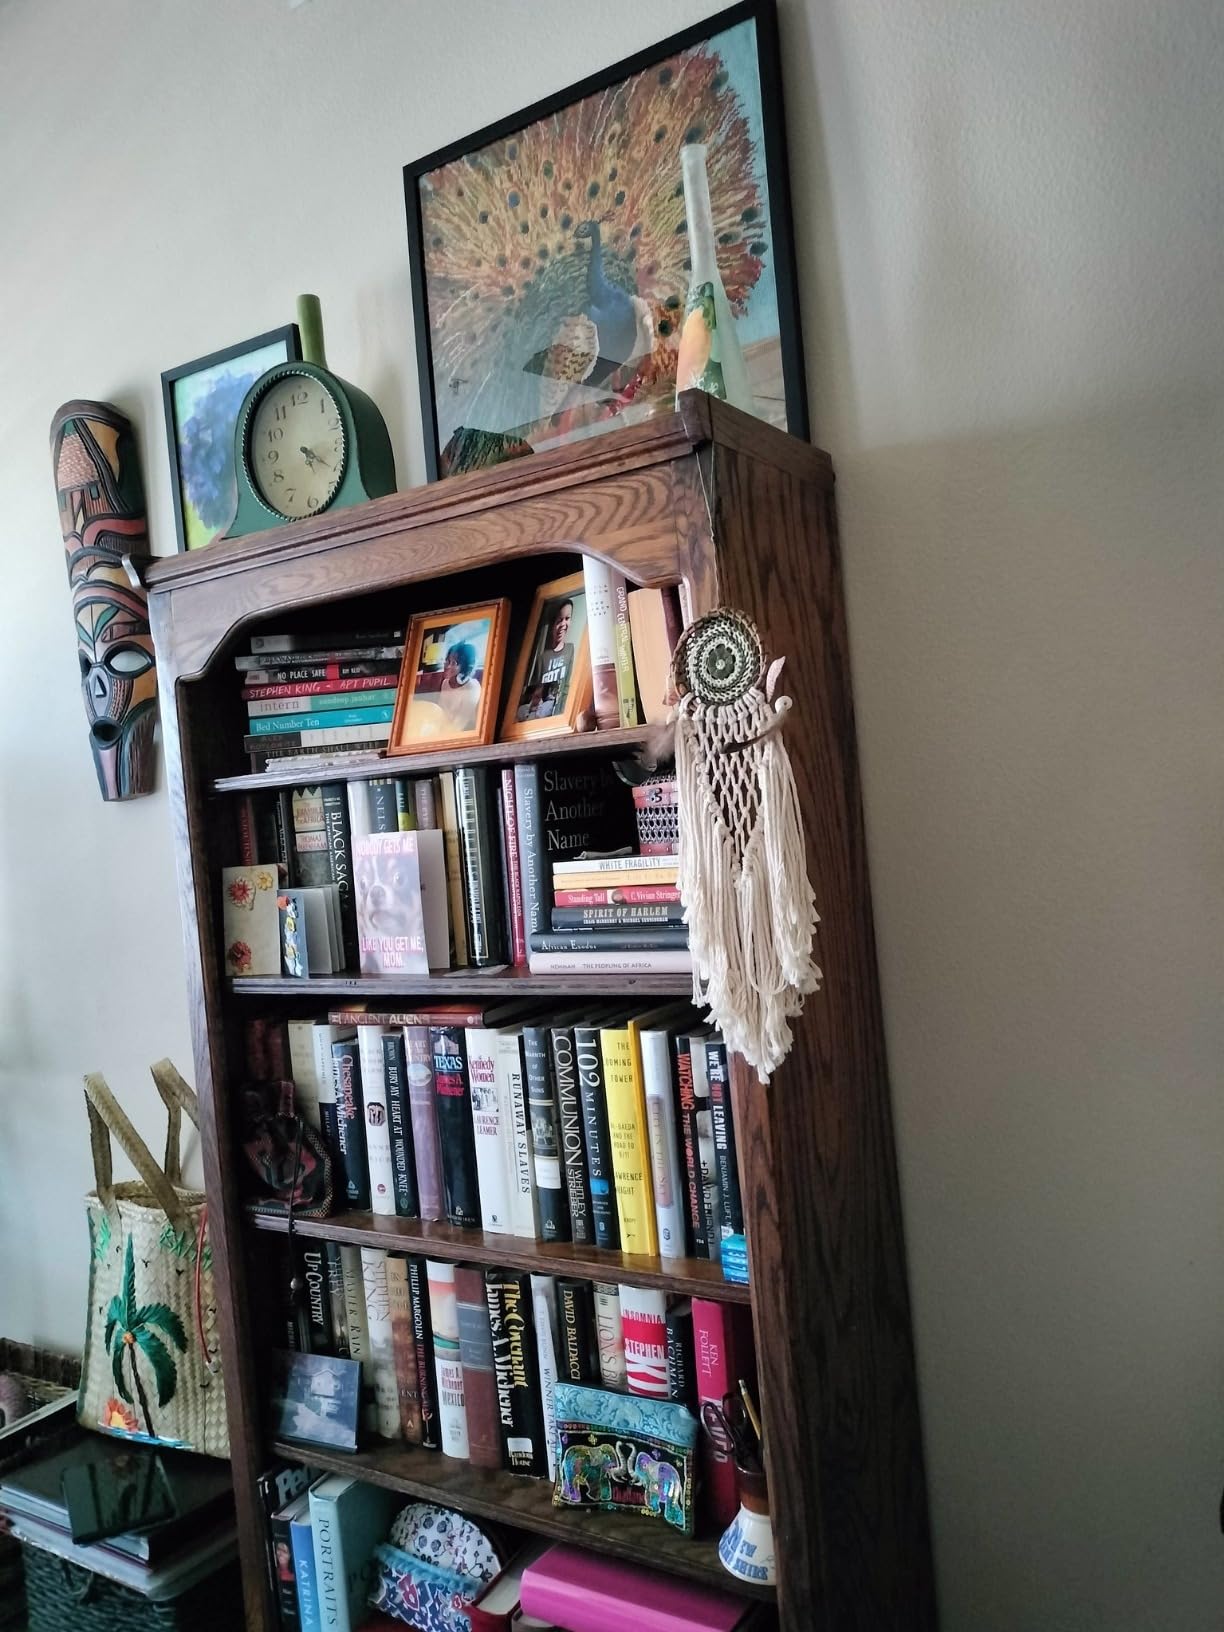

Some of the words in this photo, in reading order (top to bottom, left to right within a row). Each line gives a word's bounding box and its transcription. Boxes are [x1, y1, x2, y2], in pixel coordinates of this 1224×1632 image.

[275, 405, 287, 421] 11
[291, 391, 308, 407] 12
[268, 428, 284, 442] 10
[249, 684, 291, 698] STEPHEN
[295, 681, 321, 694] KING
[340, 679, 358, 689] APT
[363, 677, 392, 688] PUPIL
[276, 672, 287, 680] NO
[289, 670, 308, 679] PLACE
[311, 668, 326, 678] SAFE
[260, 699, 299, 713] intern
[256, 721, 271, 732] Bed
[272, 718, 303, 729] Number
[306, 717, 320, 727] Ten
[523, 788, 534, 830] Slavery
[545, 796, 605, 821] Another
[330, 812, 347, 861] BLACK
[383, 838, 401, 855] GETS
[402, 836, 414, 853] ME
[525, 834, 535, 847] by
[547, 829, 590, 851] Name
[527, 851, 538, 899] Another
[600, 861, 622, 871] WHITE
[624, 857, 661, 869] FRAGILITY
[567, 893, 593, 905] Standing
[583, 909, 614, 919] SPIRIT
[616, 908, 626, 918] OF
[631, 906, 668, 917] HARLEM
[362, 935, 377, 952] LIKE
[378, 936, 393, 952] YOU
[394, 936, 409, 952] GET
[344, 1014, 386, 1025] ANCIENT
[617, 1042, 630, 1051] THE
[388, 1066, 398, 1084] BURY
[434, 1055, 463, 1071] TEXAS
[470, 1069, 495, 1083] Women
[577, 1039, 600, 1087] 102
[610, 1074, 633, 1083] TOWER
[341, 1054, 358, 1120] Chesapeake
[390, 1085, 400, 1098] MY
[677, 1053, 696, 1111] WATCHING
[711, 1083, 724, 1103] NOT
[391, 1101, 402, 1124] HEART
[512, 1073, 526, 1137] RUNAWAY
[553, 1035, 583, 1166] COMMUNION
[336, 1103, 347, 1156] Michener
[394, 1125, 403, 1136] AT
[584, 1091, 602, 1177] MINUTES
[682, 1113, 692, 1135] THE
[712, 1105, 728, 1150] LEAVING
[394, 1138, 406, 1171] WOUNDED
[517, 1142, 530, 1194] SLAVES
[684, 1138, 696, 1177] WORLD
[399, 1173, 408, 1193] KNEE
[719, 1155, 729, 1191] BENJAMIN
[567, 1168, 579, 1218] STRIEBER
[574, 1169, 587, 1217] WHITLEY
[688, 1181, 700, 1229] CHANGE
[304, 1252, 322, 1272] UP
[327, 1261, 340, 1297] FREY
[362, 1261, 380, 1321] KING
[375, 1260, 391, 1321] STEPHEN
[409, 1264, 419, 1295] PHILLIP
[305, 1272, 324, 1326] COUNTRY
[504, 1280, 521, 1312] The
[563, 1290, 577, 1324] DAVID
[412, 1295, 424, 1340] MARGOLIN
[623, 1308, 666, 1325] INSOMNIA
[350, 1325, 361, 1355] RAIN
[504, 1313, 528, 1388] Covenant
[567, 1326, 582, 1382] BALDACCI
[597, 1314, 617, 1365] LION'S
[624, 1337, 665, 1360] STEPHEN
[698, 1328, 712, 1377] FOLLETT
[709, 1343, 719, 1366] KEN
[666, 1327, 678, 1398] BACHMAN
[675, 1342, 686, 1388] RICHARD
[442, 1390, 465, 1407] MEXICO
[494, 1350, 515, 1428] Michener
[544, 1368, 554, 1411] WINNER
[318, 1517, 339, 1626] PORTRAITS
[298, 1559, 313, 1626] KATRINA
